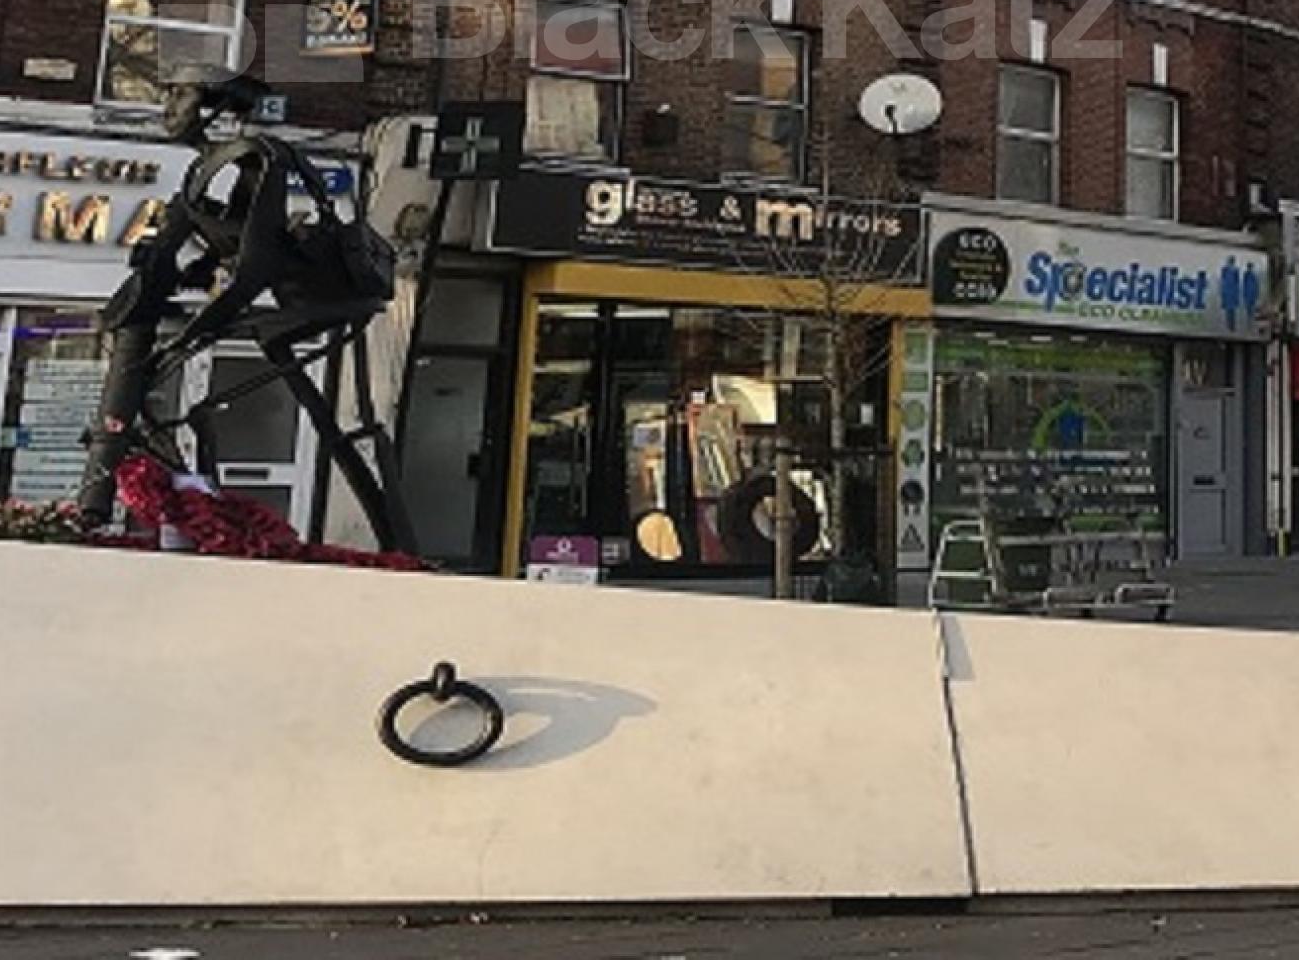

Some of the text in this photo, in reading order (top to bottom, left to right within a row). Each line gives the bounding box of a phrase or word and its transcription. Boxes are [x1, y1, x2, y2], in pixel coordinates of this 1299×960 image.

[585, 177, 699, 226] glass
[720, 195, 742, 221] &
[754, 198, 902, 241] mirrors
[1023, 250, 1208, 312] Specialist
